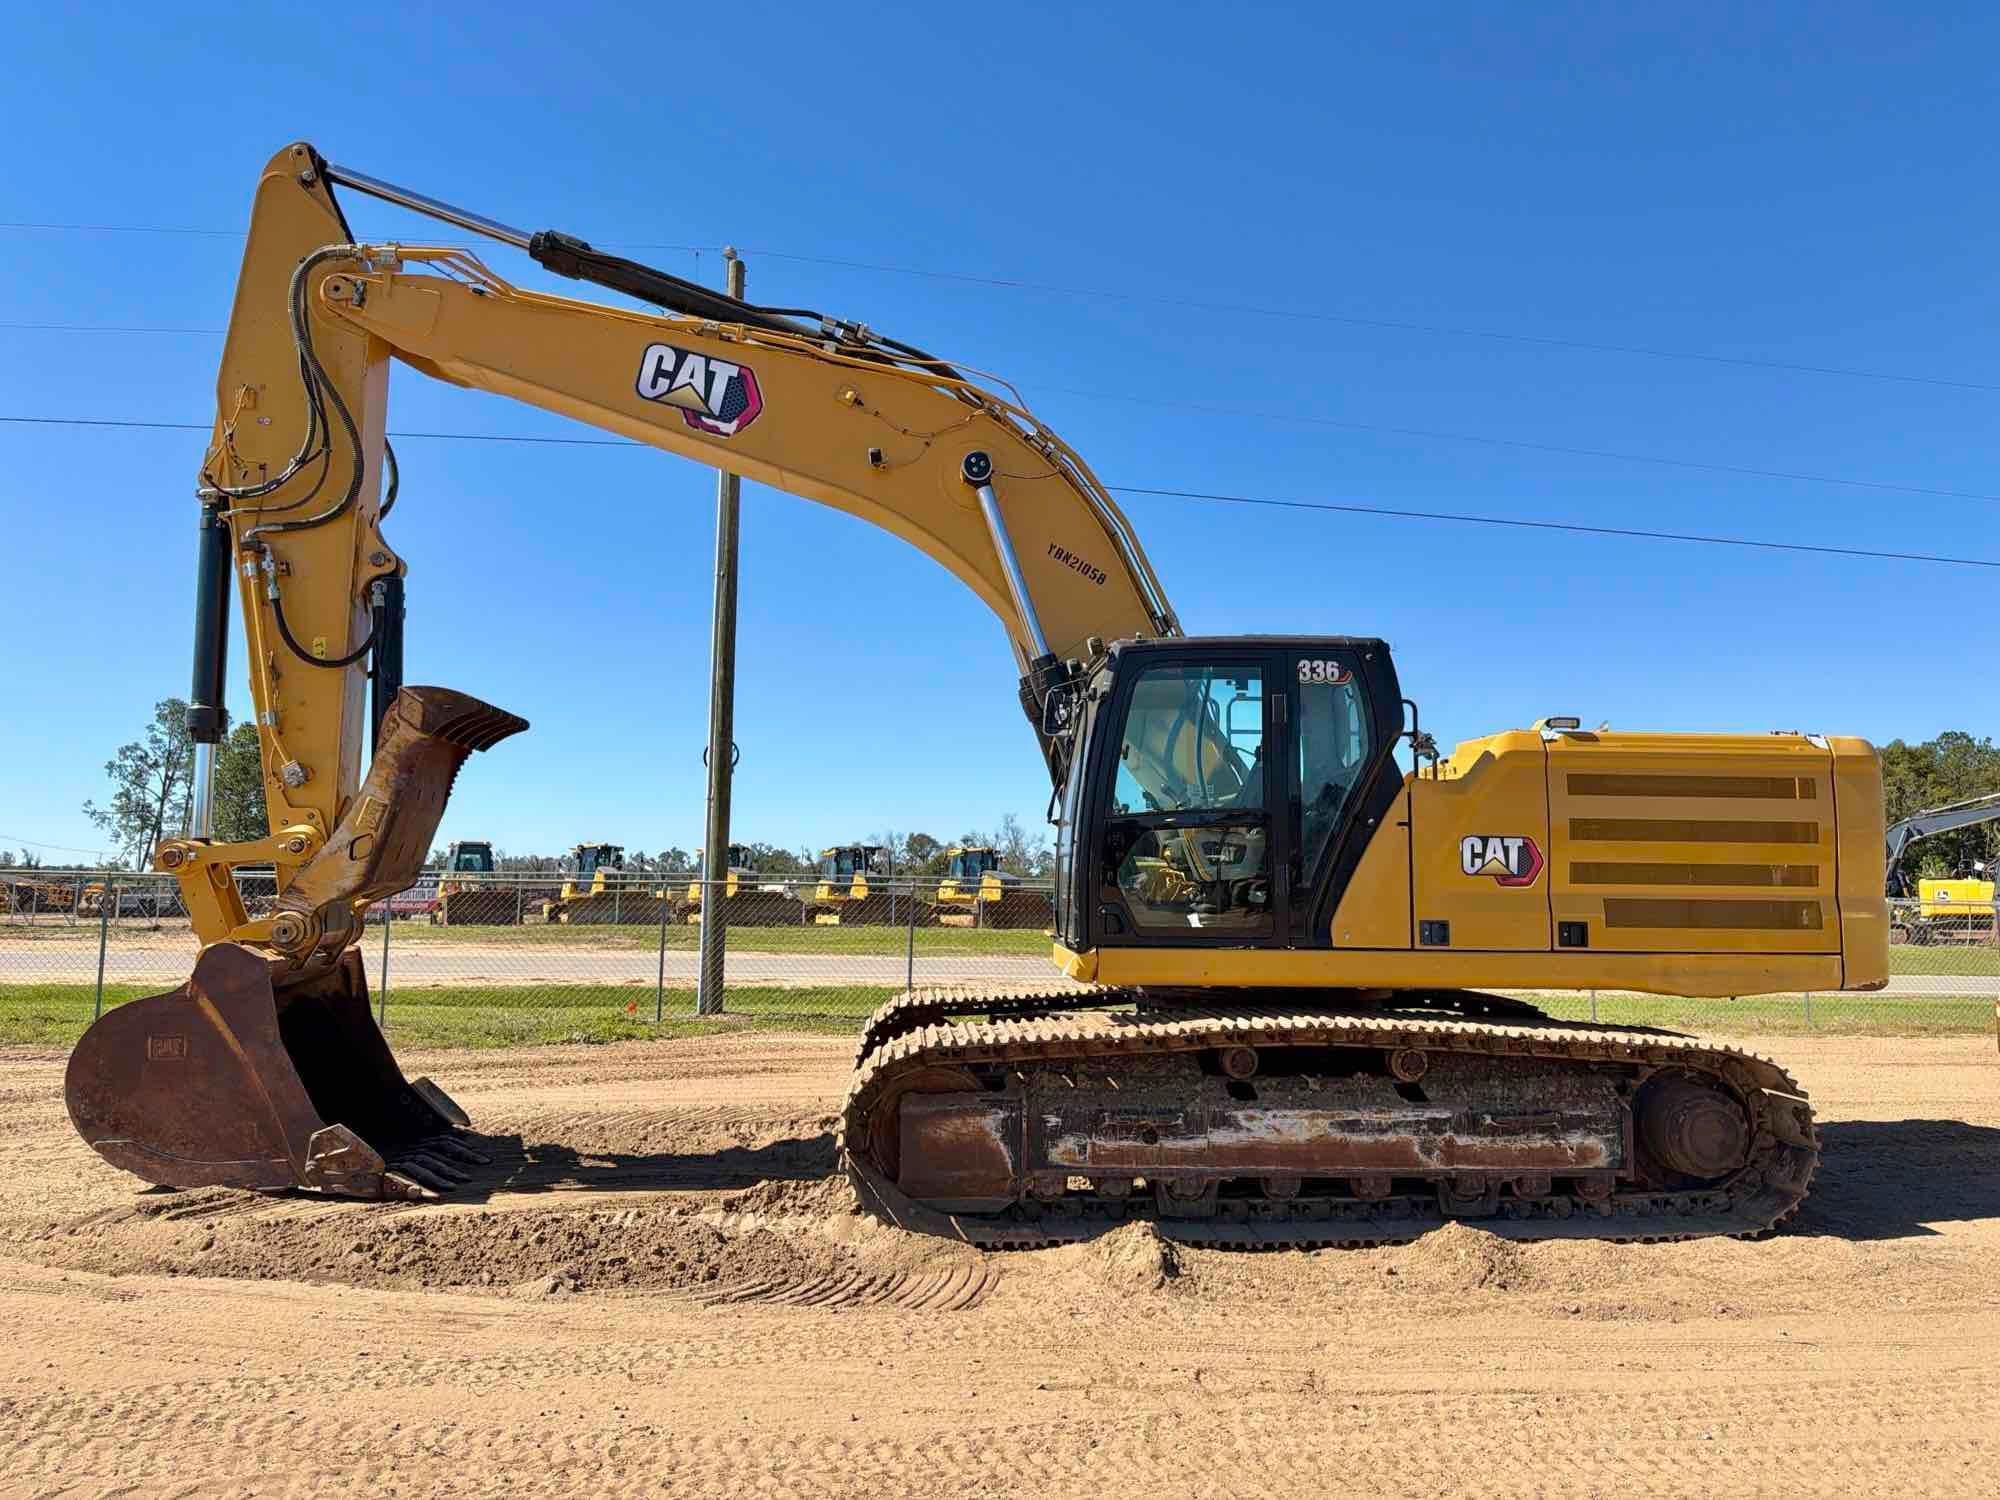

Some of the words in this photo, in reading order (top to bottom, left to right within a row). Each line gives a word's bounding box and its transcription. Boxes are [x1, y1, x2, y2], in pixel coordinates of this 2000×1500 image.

[638, 343, 740, 417] CAT
[1297, 659, 1340, 682] 336
[1462, 836, 1524, 874] CAT
